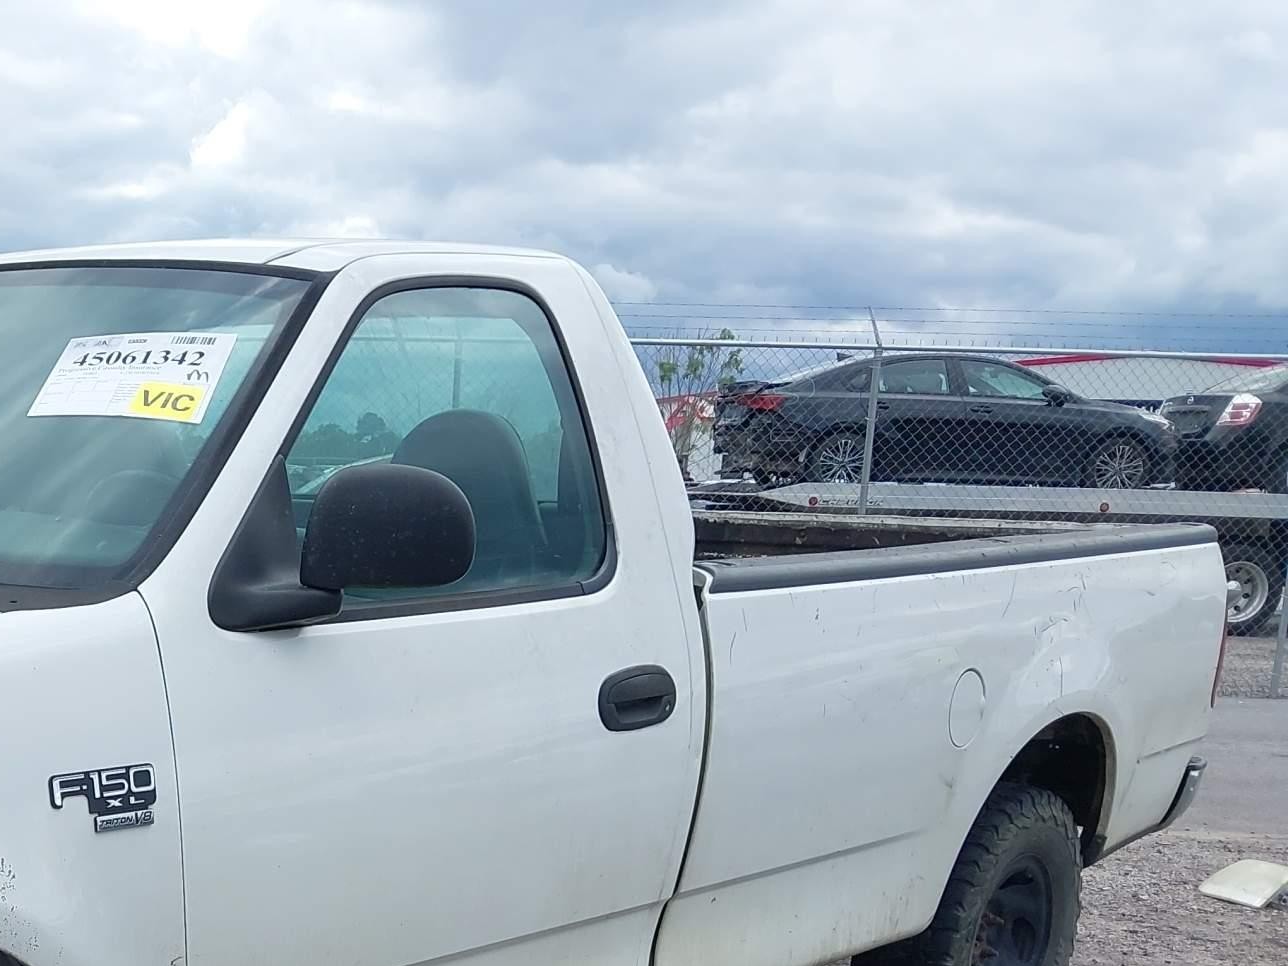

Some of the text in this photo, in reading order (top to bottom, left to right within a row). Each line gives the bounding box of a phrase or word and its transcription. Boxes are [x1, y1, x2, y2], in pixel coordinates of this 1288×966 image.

[73, 350, 205, 367] 45061342
[143, 390, 195, 412] VIC
[51, 765, 155, 807] F-150
[99, 811, 153, 829] TRITON V8
